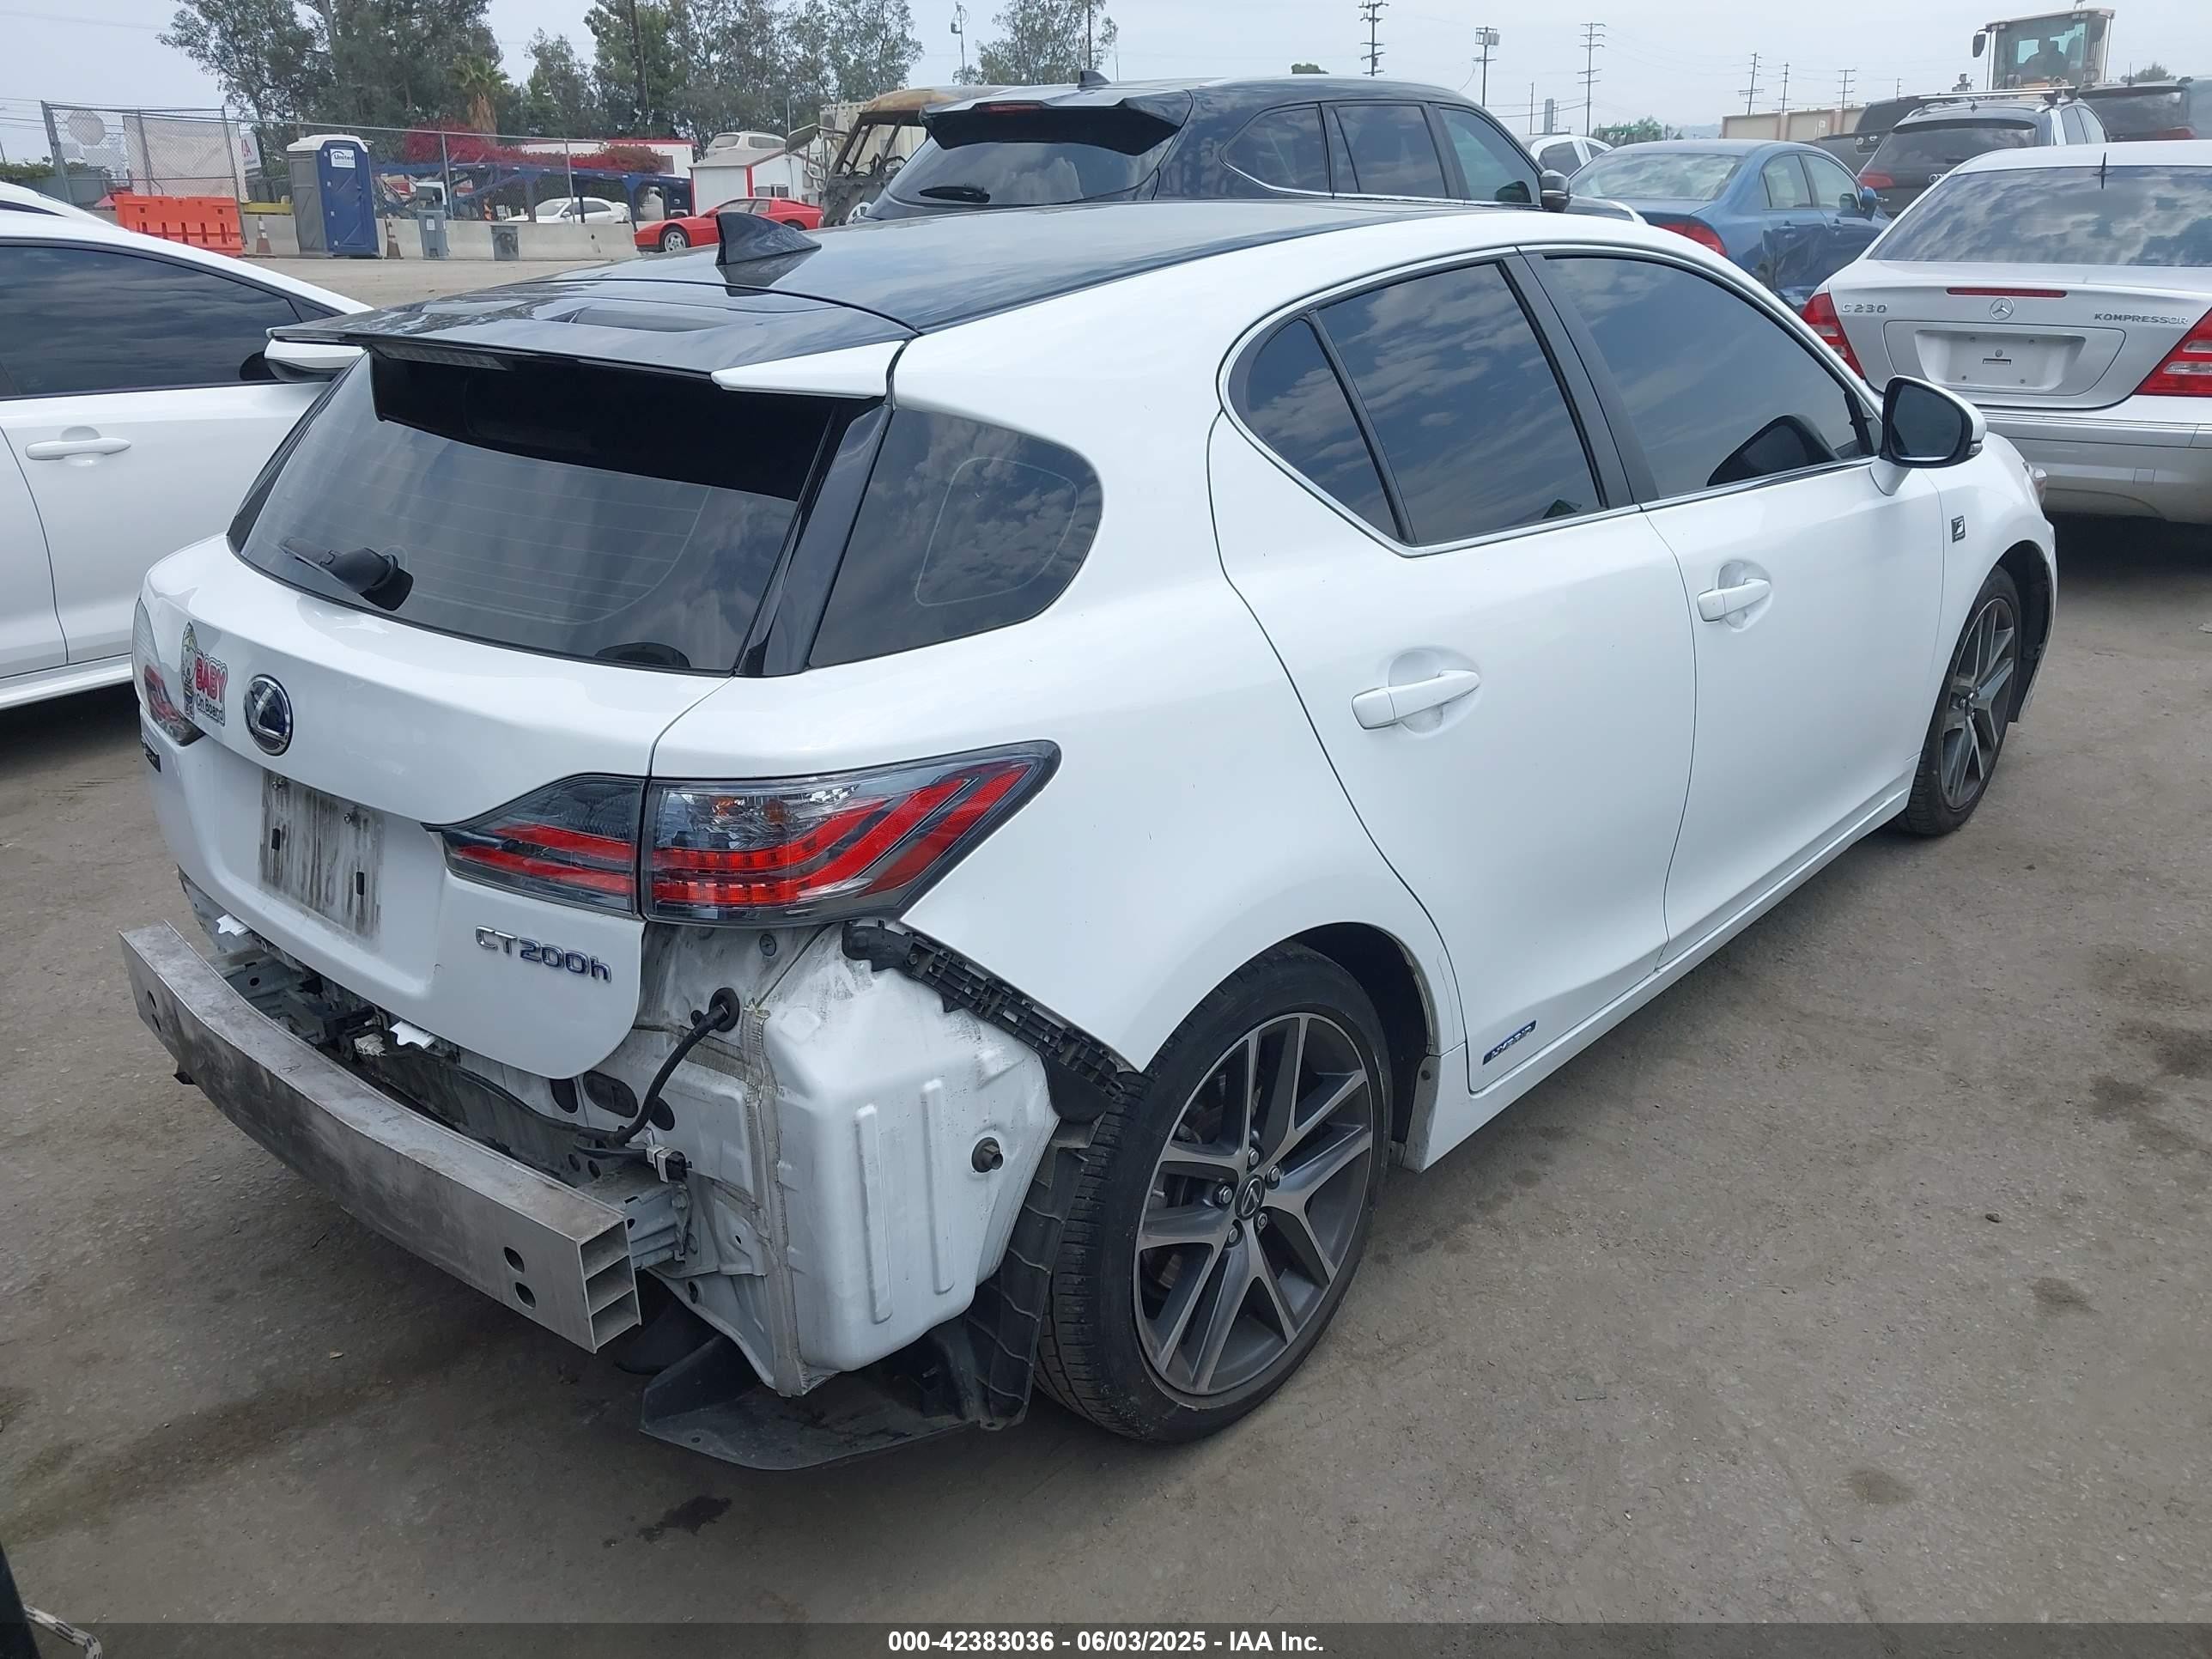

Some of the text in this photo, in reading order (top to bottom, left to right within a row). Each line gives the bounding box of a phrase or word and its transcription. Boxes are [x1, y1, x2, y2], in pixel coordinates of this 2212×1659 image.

[2094, 313, 2188, 325] KOMPRESSOR
[196, 656, 226, 703] BABY
[196, 694, 223, 721] On Board
